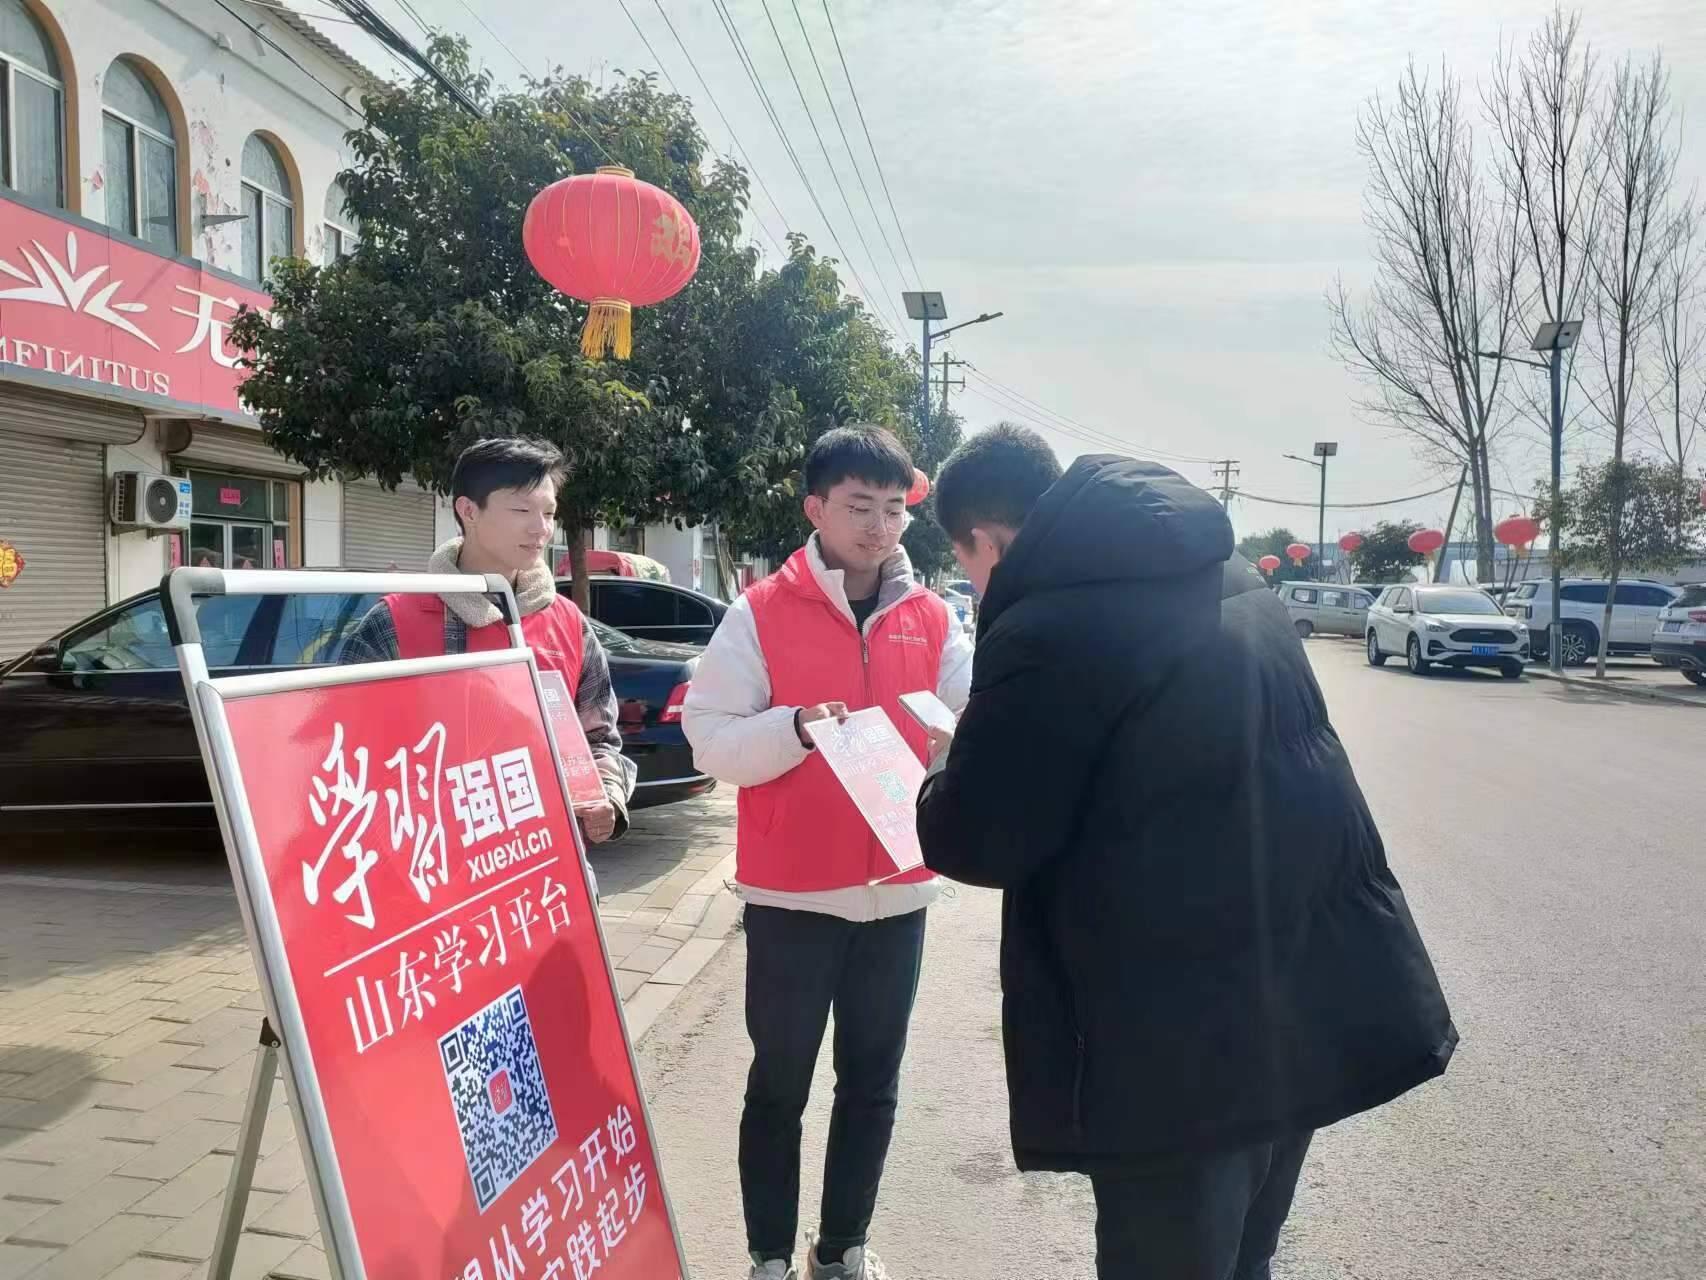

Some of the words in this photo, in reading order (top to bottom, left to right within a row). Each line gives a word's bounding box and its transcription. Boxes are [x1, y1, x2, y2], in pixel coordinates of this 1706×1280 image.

[466, 826, 554, 883] xuexi.cn
[344, 875, 573, 1055] 山东学习平台
